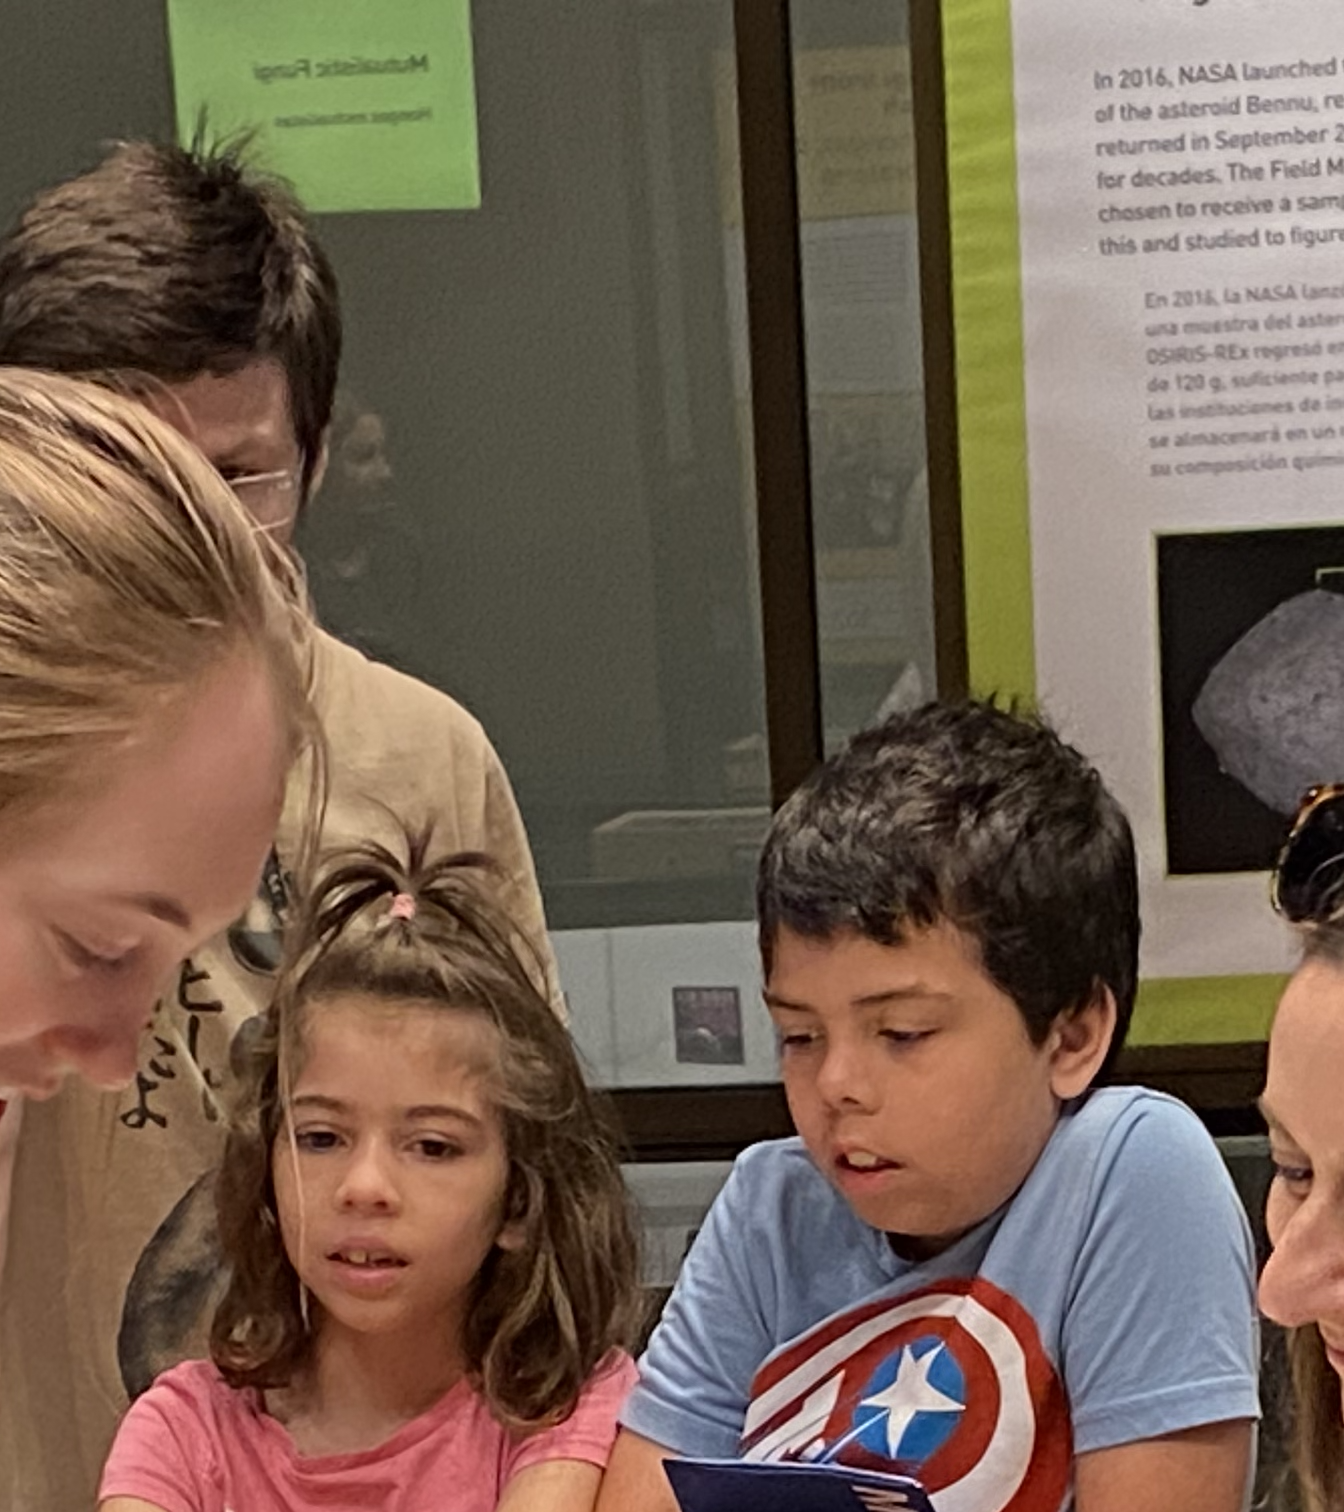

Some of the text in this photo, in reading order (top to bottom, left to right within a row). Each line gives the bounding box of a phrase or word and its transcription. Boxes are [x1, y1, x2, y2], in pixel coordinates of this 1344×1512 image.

[1093, 69, 1114, 90] In
[1178, 61, 1238, 84] NASA
[1242, 55, 1338, 80] launched
[1095, 102, 1115, 122] of
[1120, 100, 1153, 121] the
[1158, 94, 1241, 118] asteroid
[1095, 132, 1187, 156] returned
[1190, 130, 1211, 150] in
[1215, 123, 1327, 154] September
[1096, 168, 1125, 188] for
[1228, 160, 1265, 181] The
[1270, 157, 1322, 179] Field
[1098, 199, 1172, 223] chosen
[1175, 200, 1197, 218] to
[1200, 193, 1275, 217] receive
[1279, 197, 1292, 212] a
[1098, 234, 1137, 255] this
[1142, 232, 1181, 253] and
[1185, 227, 1261, 250] studied
[1264, 228, 1286, 246] to
